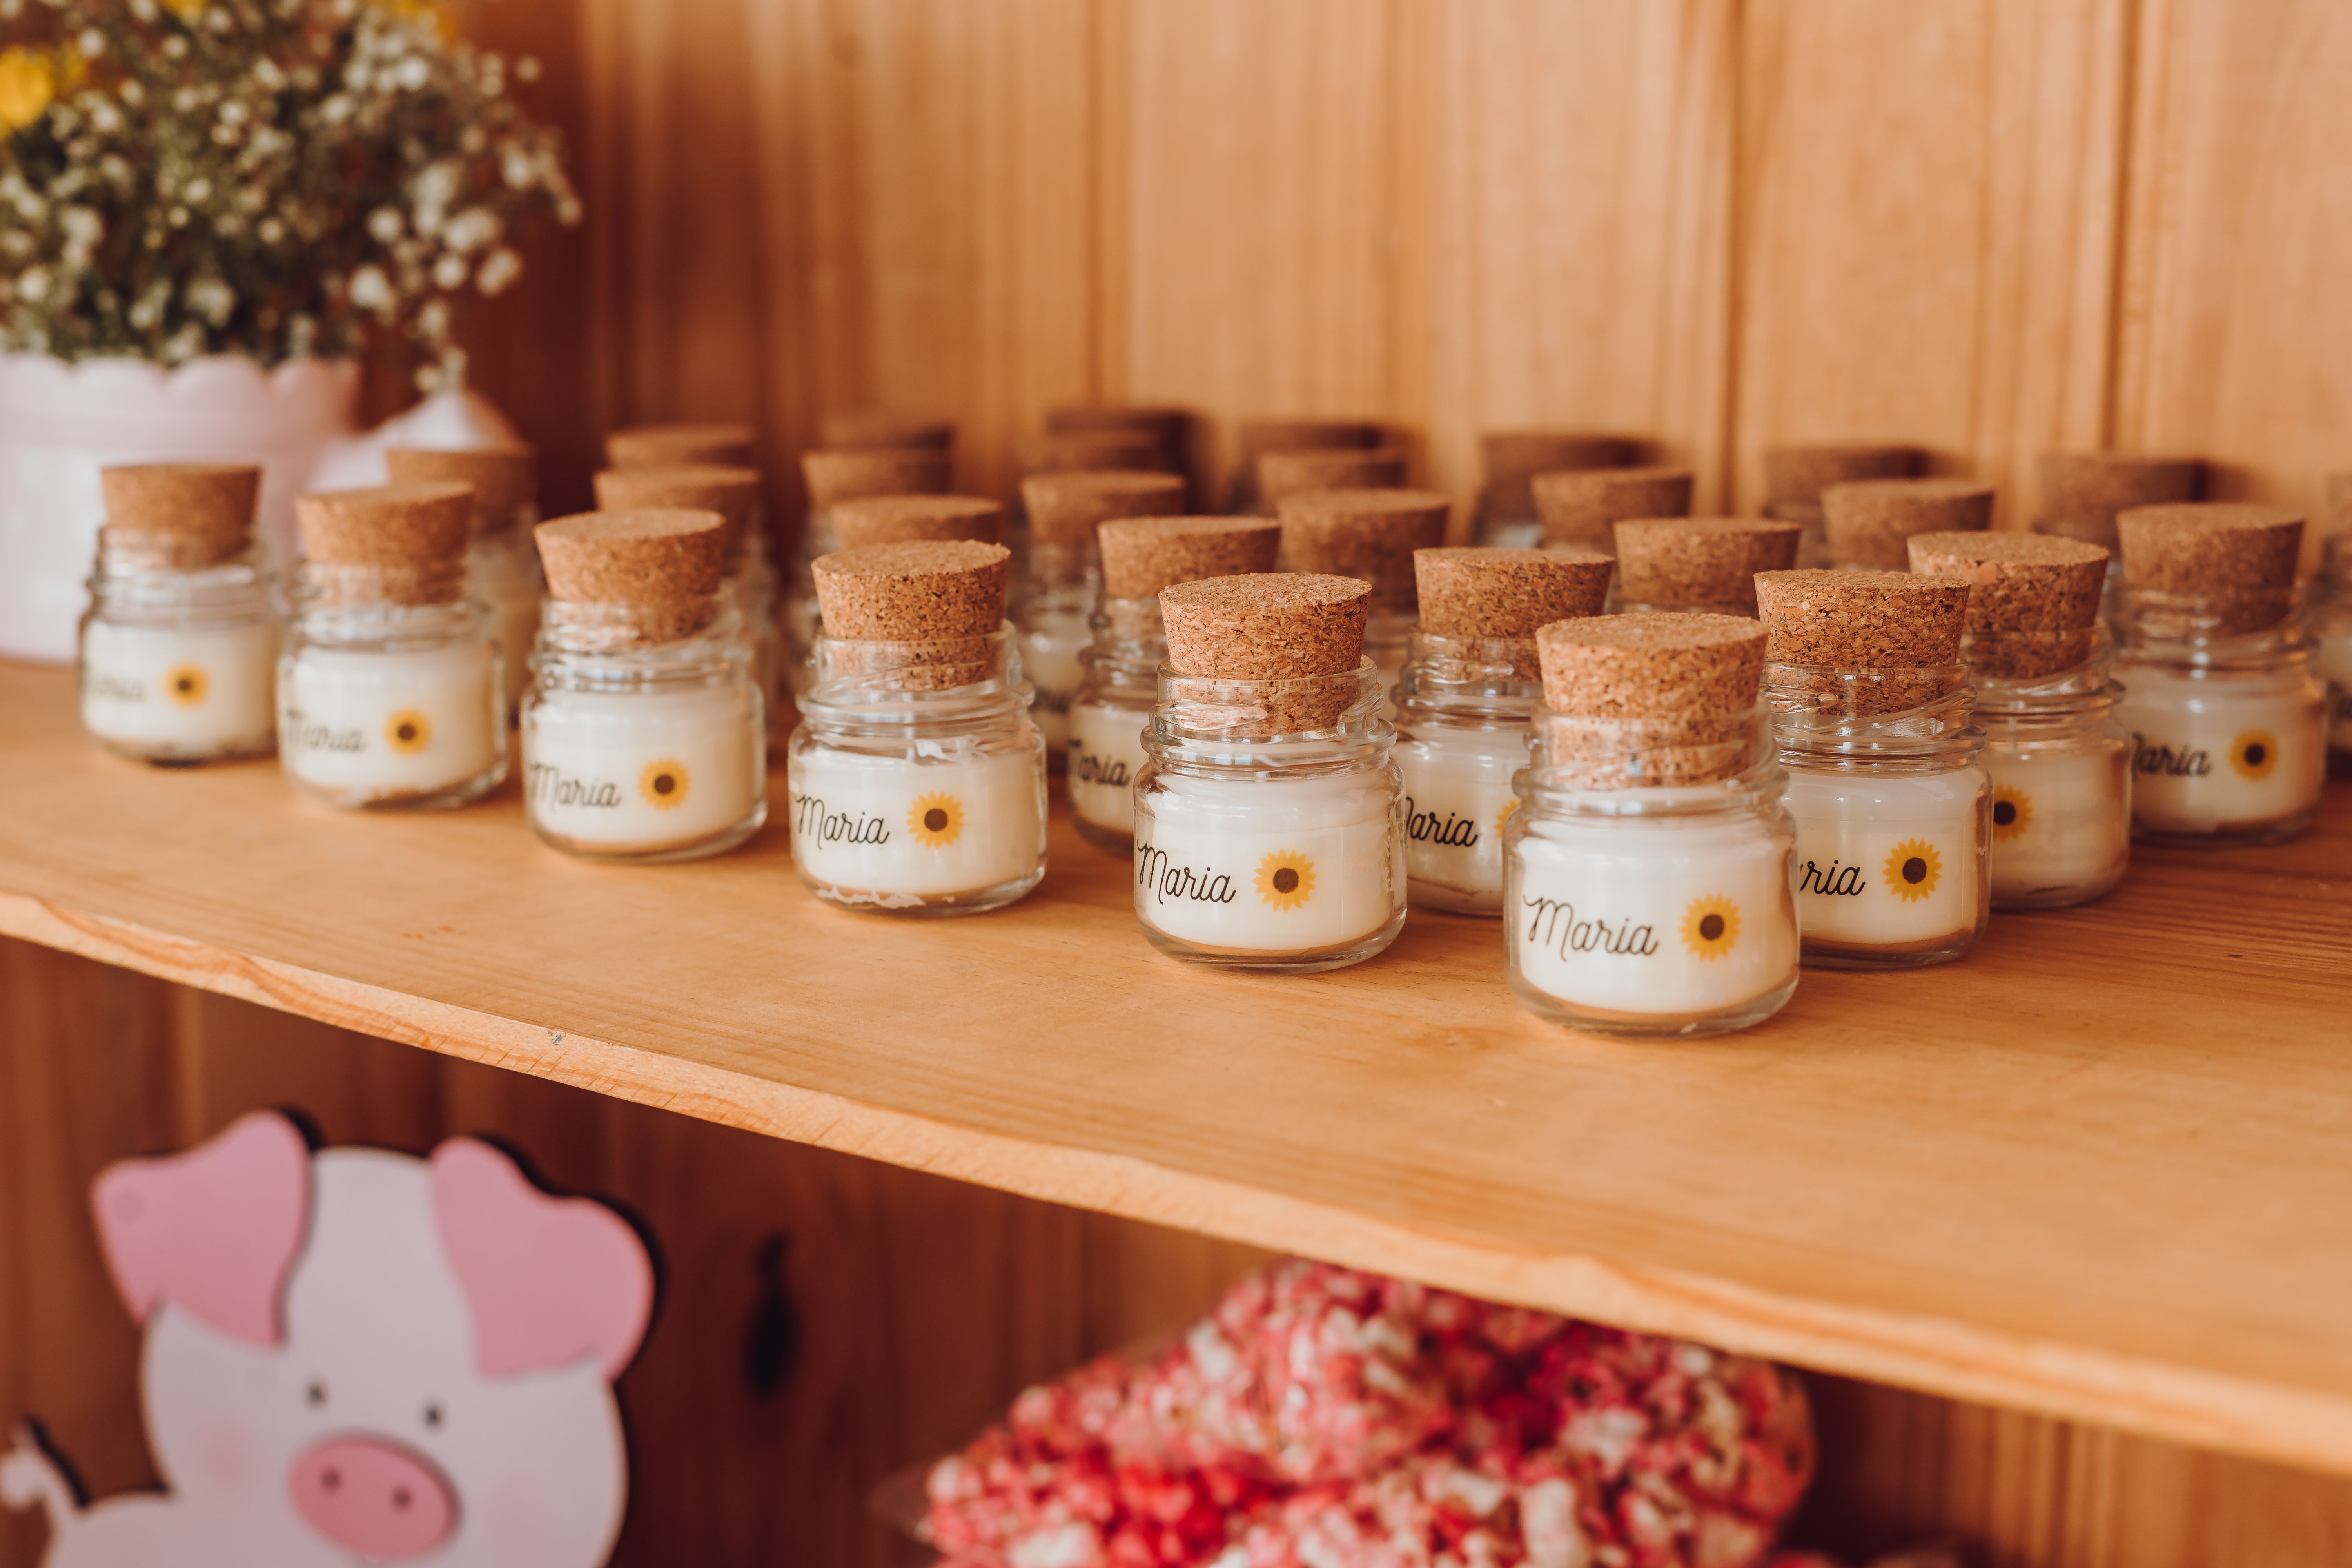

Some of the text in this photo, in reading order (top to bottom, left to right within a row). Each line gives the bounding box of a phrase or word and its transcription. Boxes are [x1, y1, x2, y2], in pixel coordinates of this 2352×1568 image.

[529, 762, 622, 815] Maria
[794, 793, 890, 850] Maria
[1137, 839, 1236, 905] Maria
[1523, 893, 1659, 963] Maria
